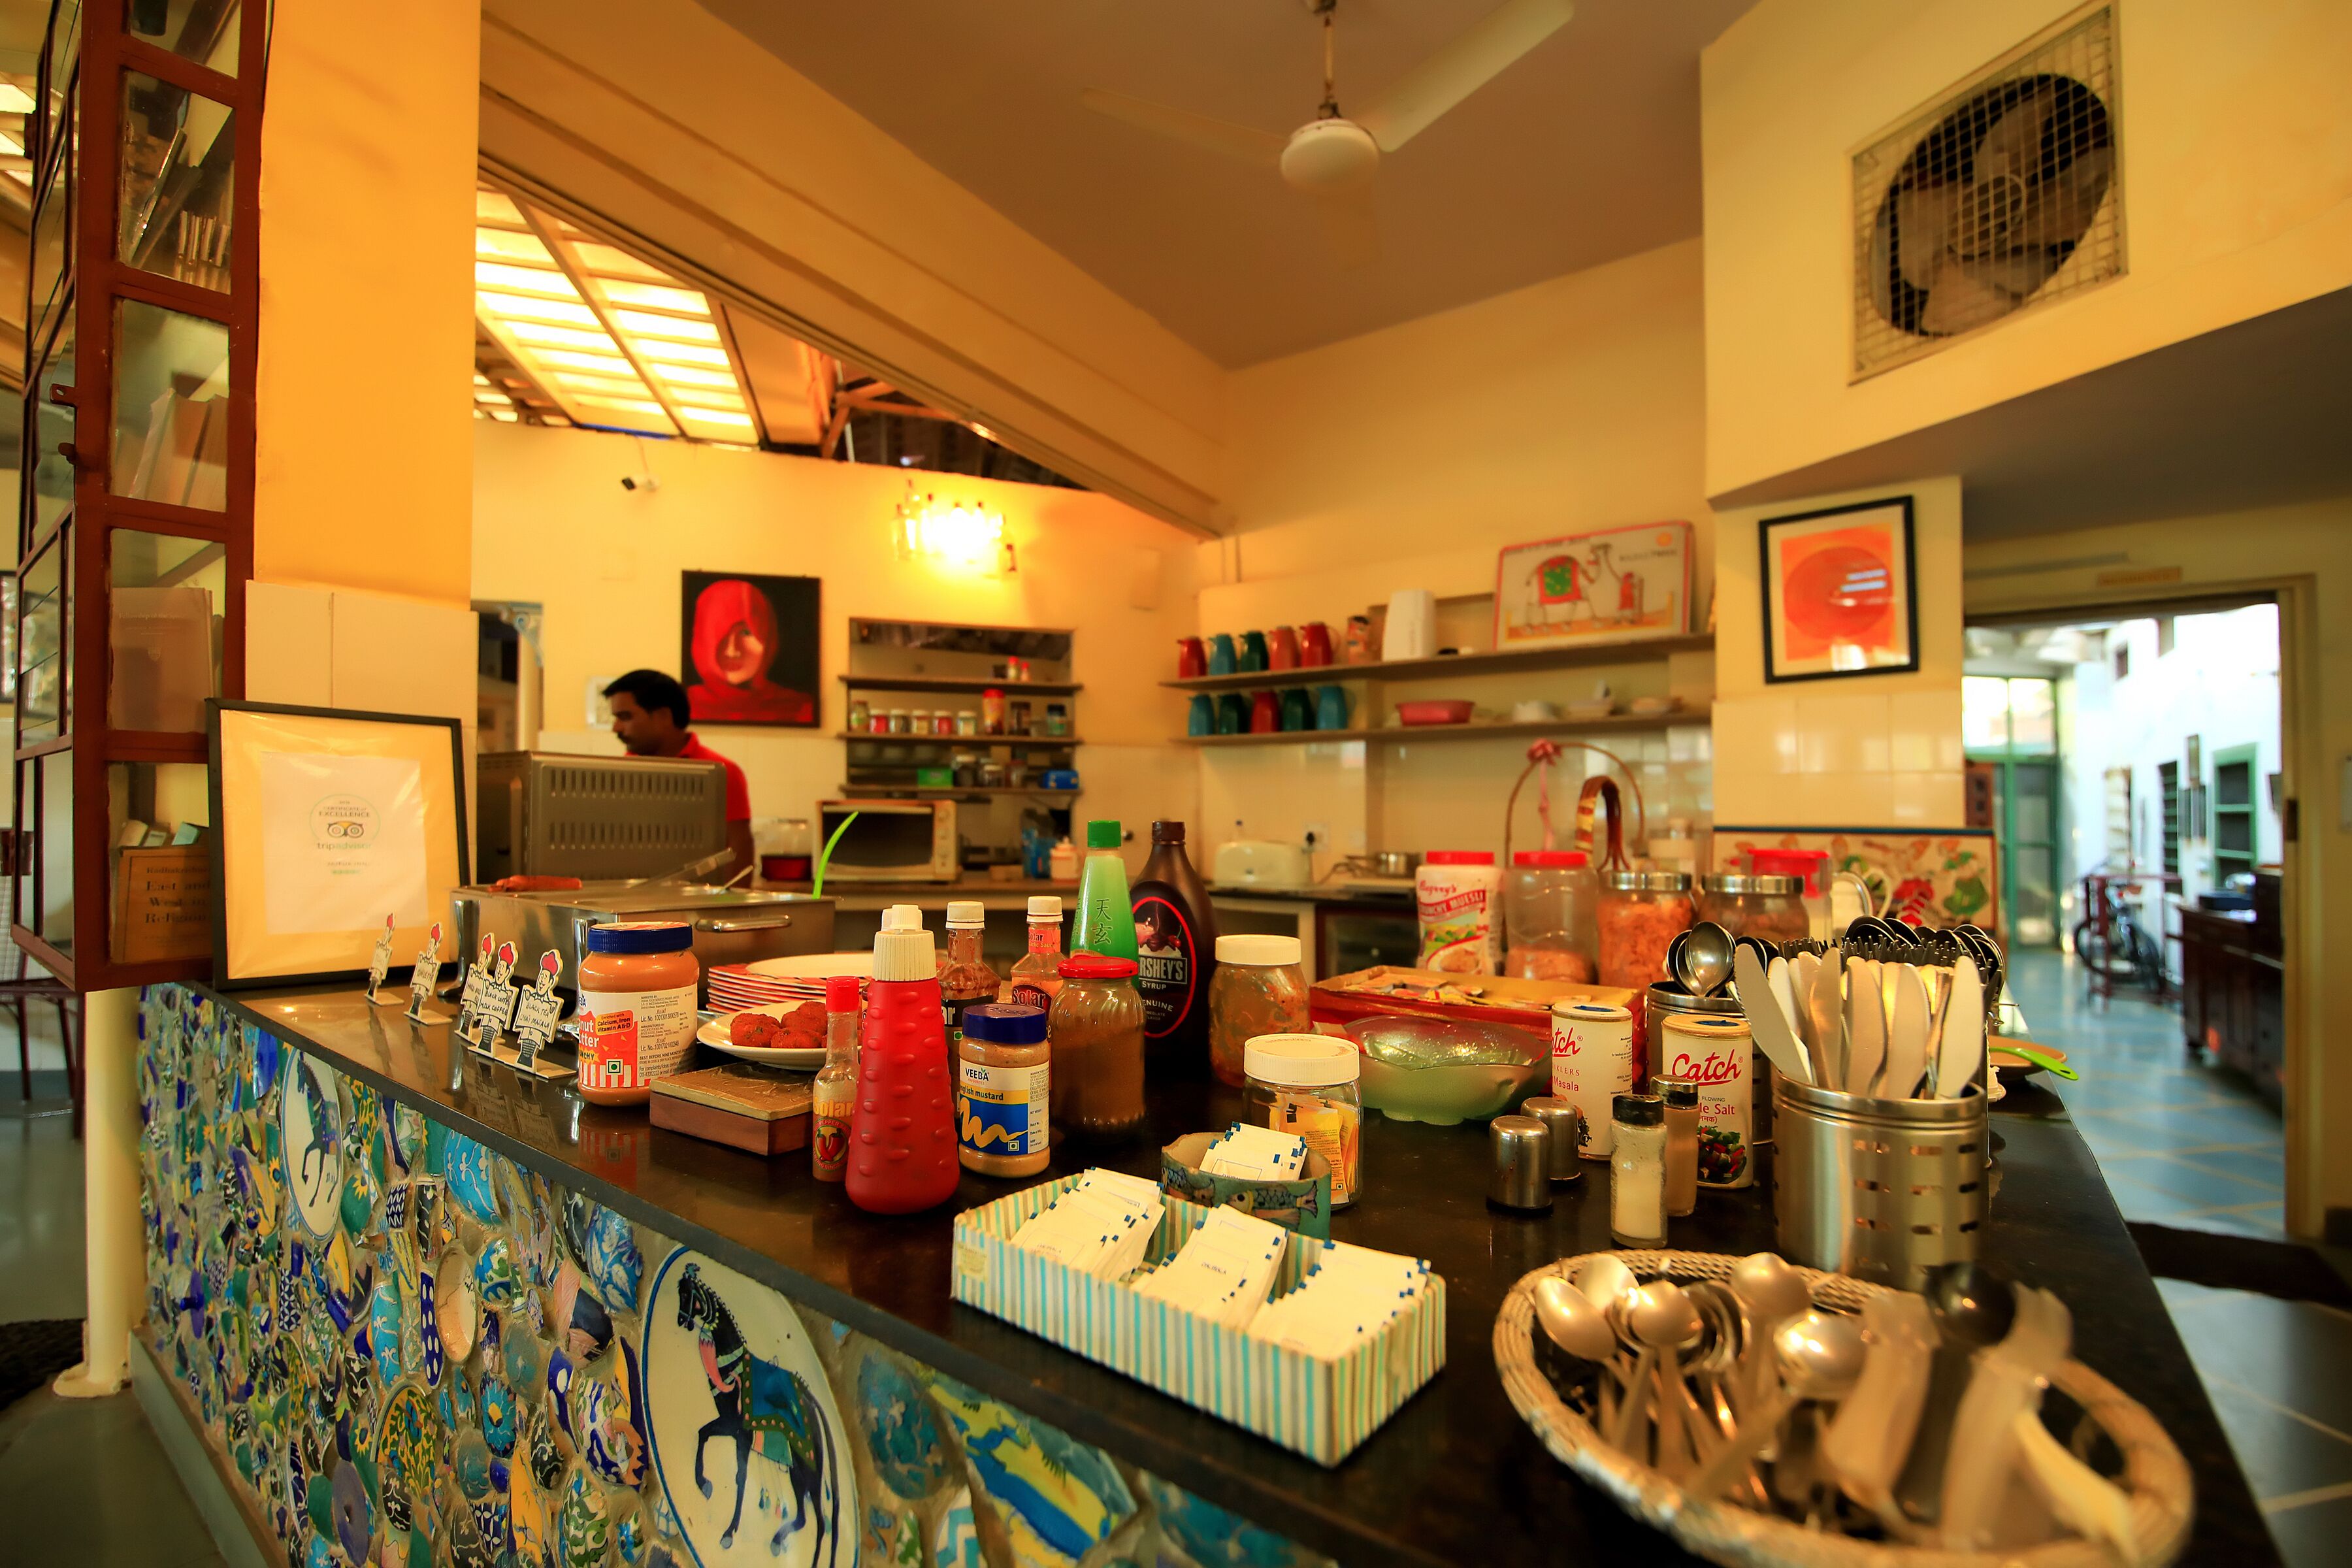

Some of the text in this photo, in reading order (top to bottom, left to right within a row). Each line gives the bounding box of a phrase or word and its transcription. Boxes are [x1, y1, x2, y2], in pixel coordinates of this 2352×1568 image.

[317, 841, 372, 851] tripadvisor
[146, 881, 176, 891] East
[150, 897, 184, 907] West
[1141, 981, 1167, 990] SYRUP
[484, 990, 498, 1001] BLACK
[1013, 987, 1046, 1007] Solar
[480, 1002, 508, 1015] MILK COFFEE
[525, 1002, 549, 1018] BLACK TEA
[531, 1017, 550, 1028] MASALA
[1672, 1049, 1742, 1082] Catch
[965, 1067, 989, 1081] VEEBA
[1554, 1075, 1579, 1092] Masala
[975, 1090, 1004, 1101] mustard
[813, 1097, 854, 1118] Solar
[1714, 1103, 1735, 1115] Salt
